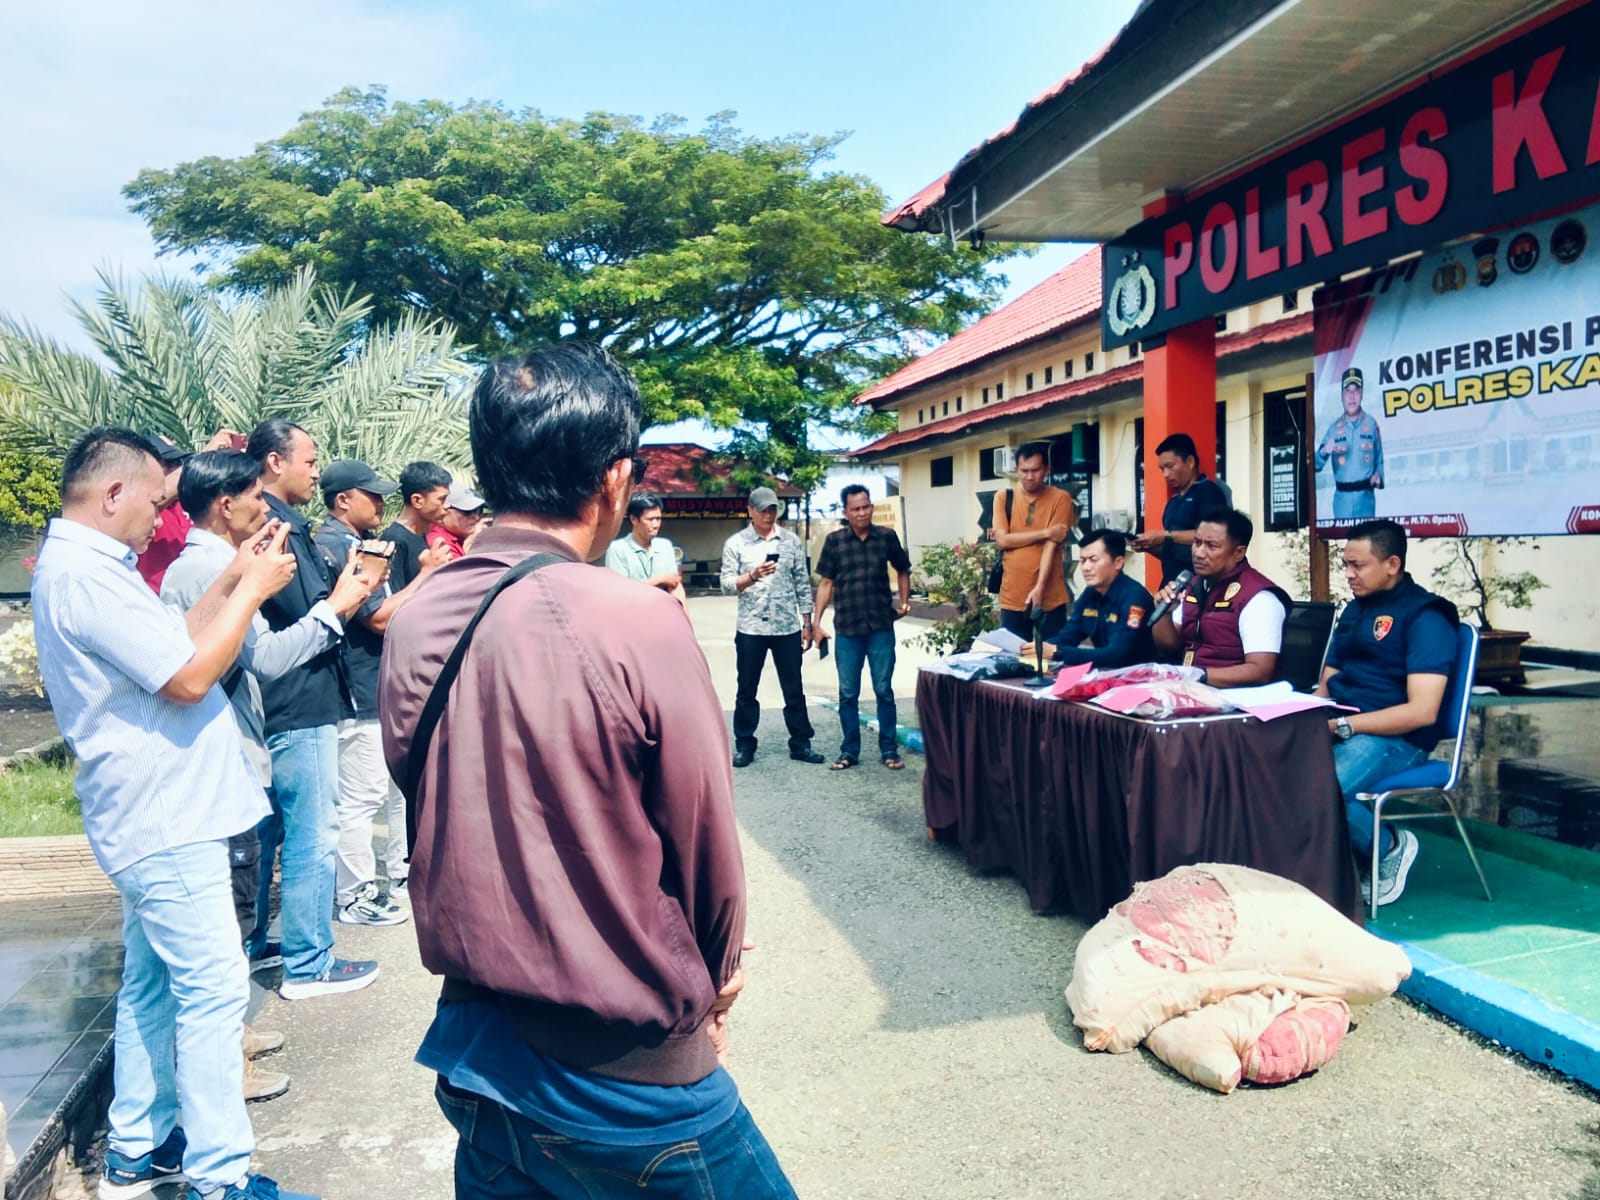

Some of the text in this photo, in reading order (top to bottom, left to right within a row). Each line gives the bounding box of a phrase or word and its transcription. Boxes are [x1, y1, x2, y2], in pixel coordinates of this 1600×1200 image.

[1164, 46, 1600, 311] POLRES K
[1379, 321, 1573, 385] KONFERENSI
[1383, 352, 1600, 418] POLRES KA
